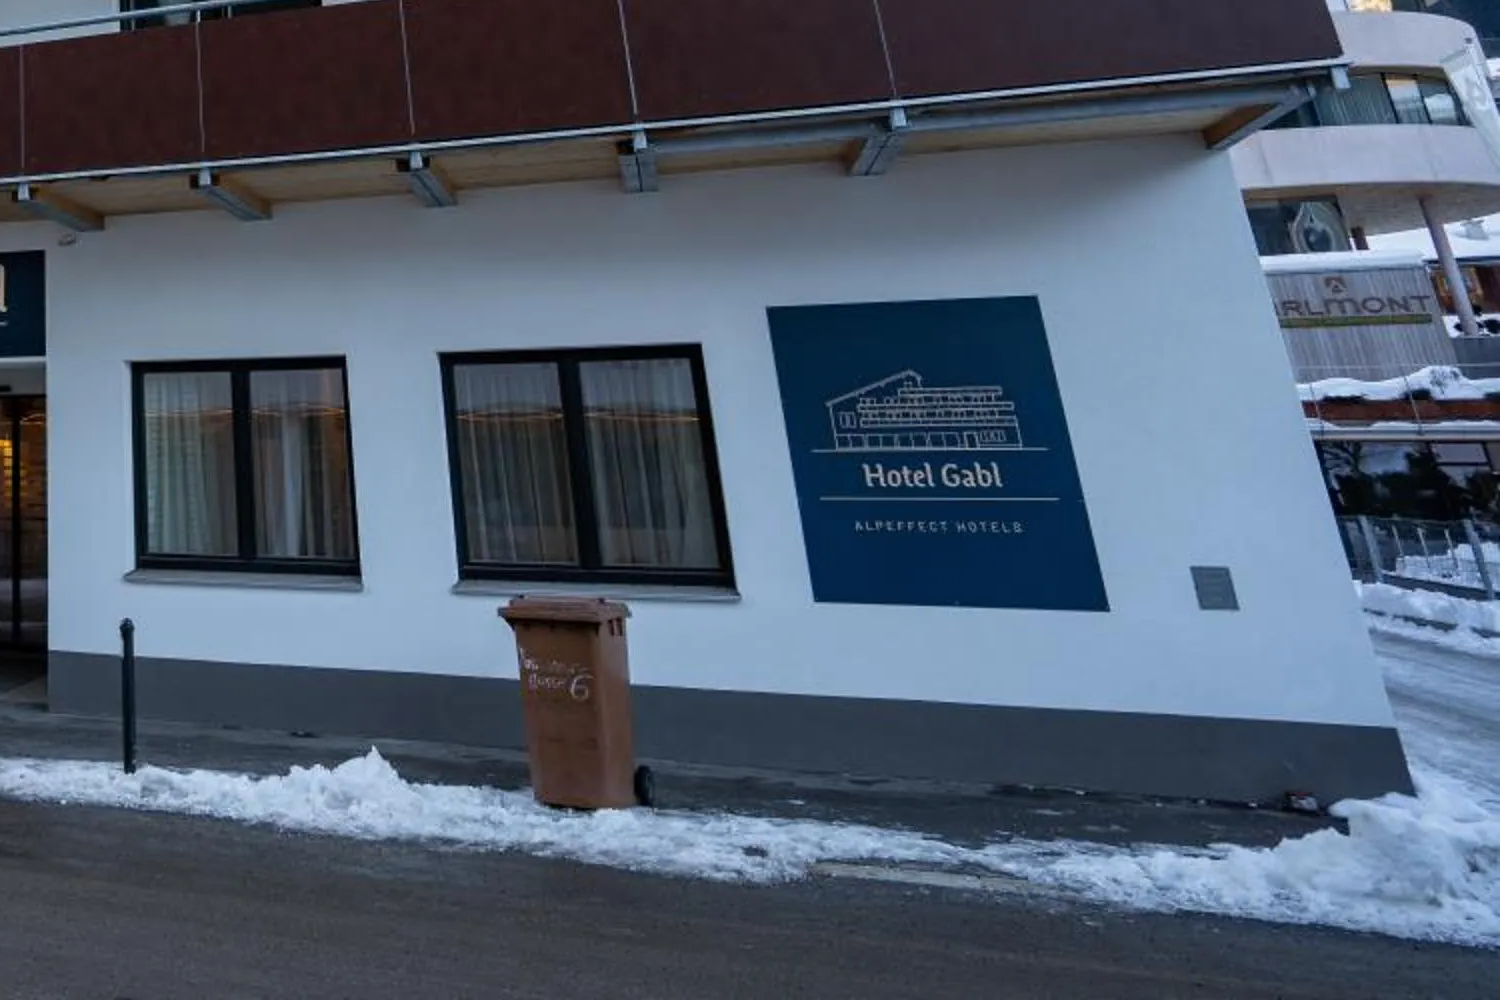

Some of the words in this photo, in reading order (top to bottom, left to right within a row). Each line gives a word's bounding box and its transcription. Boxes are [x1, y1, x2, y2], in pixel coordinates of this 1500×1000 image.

[861, 461, 936, 488] Hotel
[941, 461, 1004, 488] Gabl
[854, 520, 948, 534] ALPEFFECT
[956, 521, 1024, 534] HOTELS
[571, 672, 596, 700] 6
